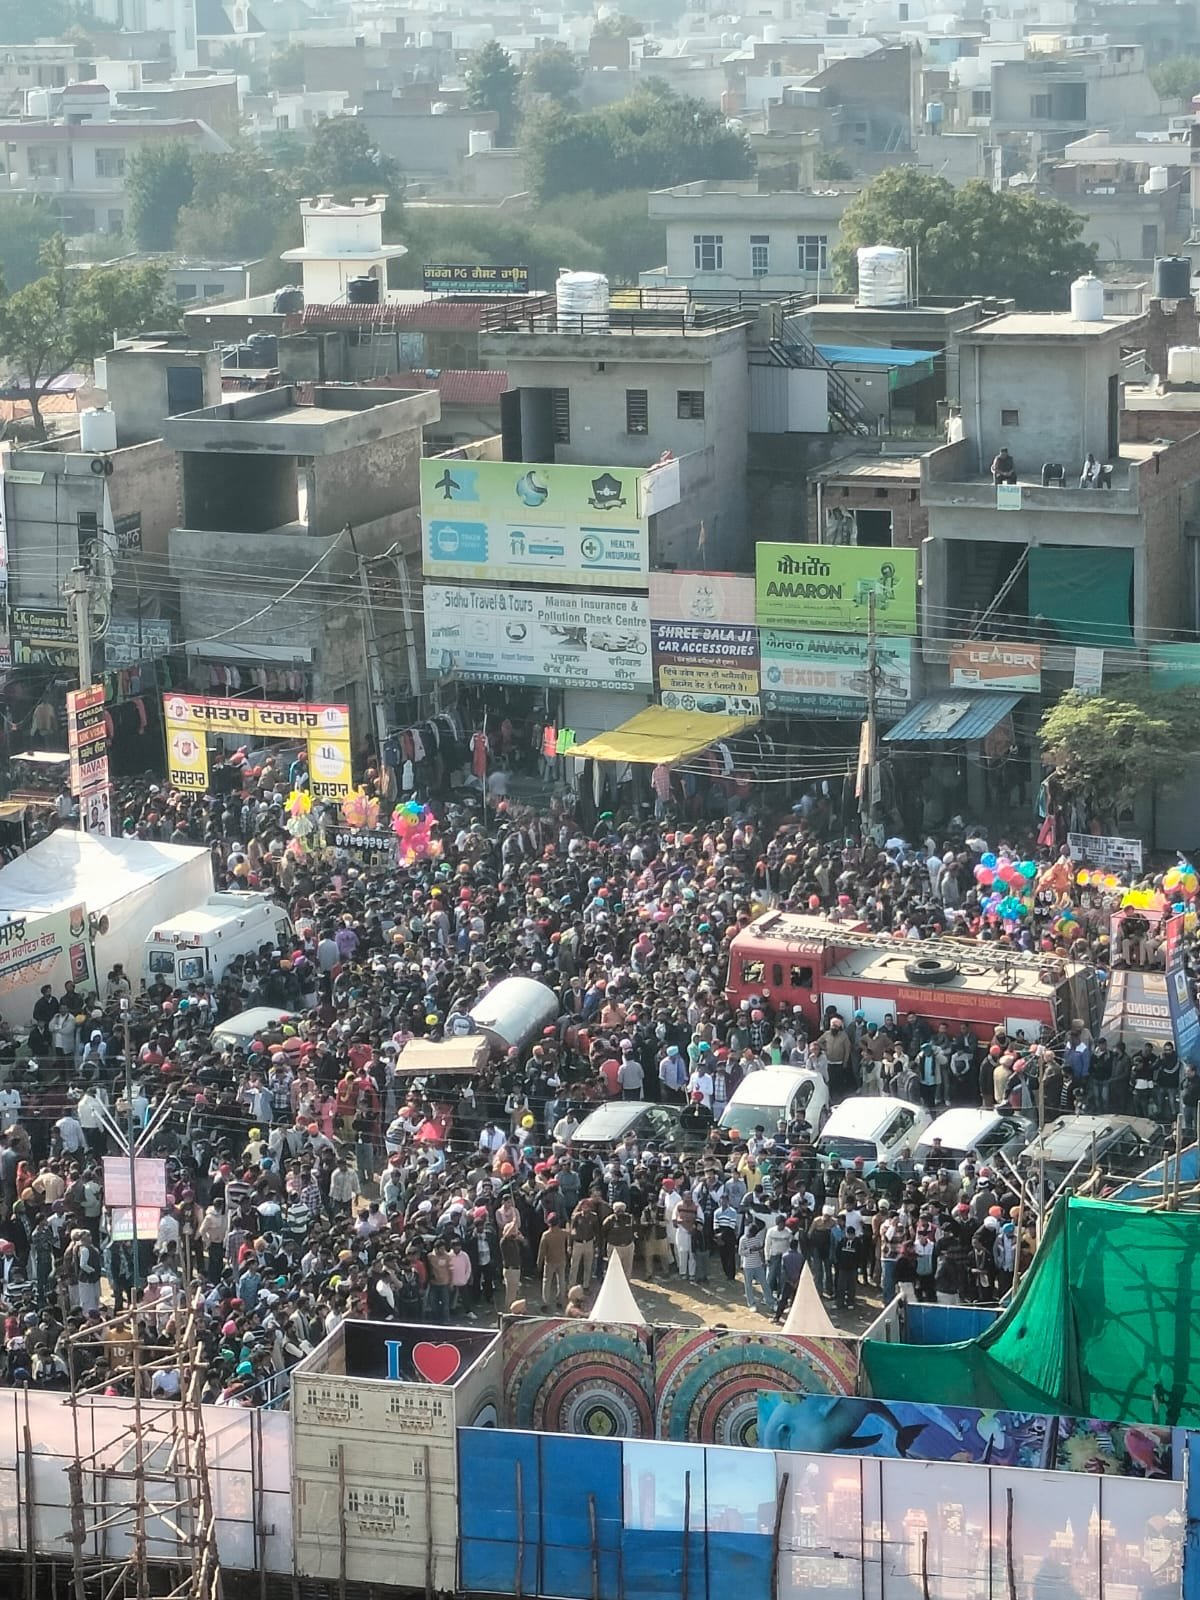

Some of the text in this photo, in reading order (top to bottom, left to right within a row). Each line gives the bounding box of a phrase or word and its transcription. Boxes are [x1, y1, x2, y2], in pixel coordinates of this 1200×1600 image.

[454, 268, 468, 279] PG
[610, 540, 635, 549] HEALTH
[605, 551, 641, 561] INSURANCE
[766, 581, 842, 600] AMARON
[445, 591, 534, 612] Sidhu Travel & Tours
[545, 596, 639, 612] Manan Insurance &
[538, 610, 647, 628] Pollution Check Centre
[658, 626, 752, 642] SHREE BALA JI
[658, 641, 755, 656] CAR ACCESSORIES
[808, 639, 860, 656] AMARON
[969, 645, 1037, 669] LEADER
[783, 668, 837, 688] EXIDE
[78, 705, 104, 720] CANADA
[191, 704, 250, 722] ਦਸਤਾਰ
[259, 710, 318, 727] ਦਰਬਾਰ
[171, 769, 205, 786] ਦਸਤਾਰ
[384, 1340, 402, 1381] I
